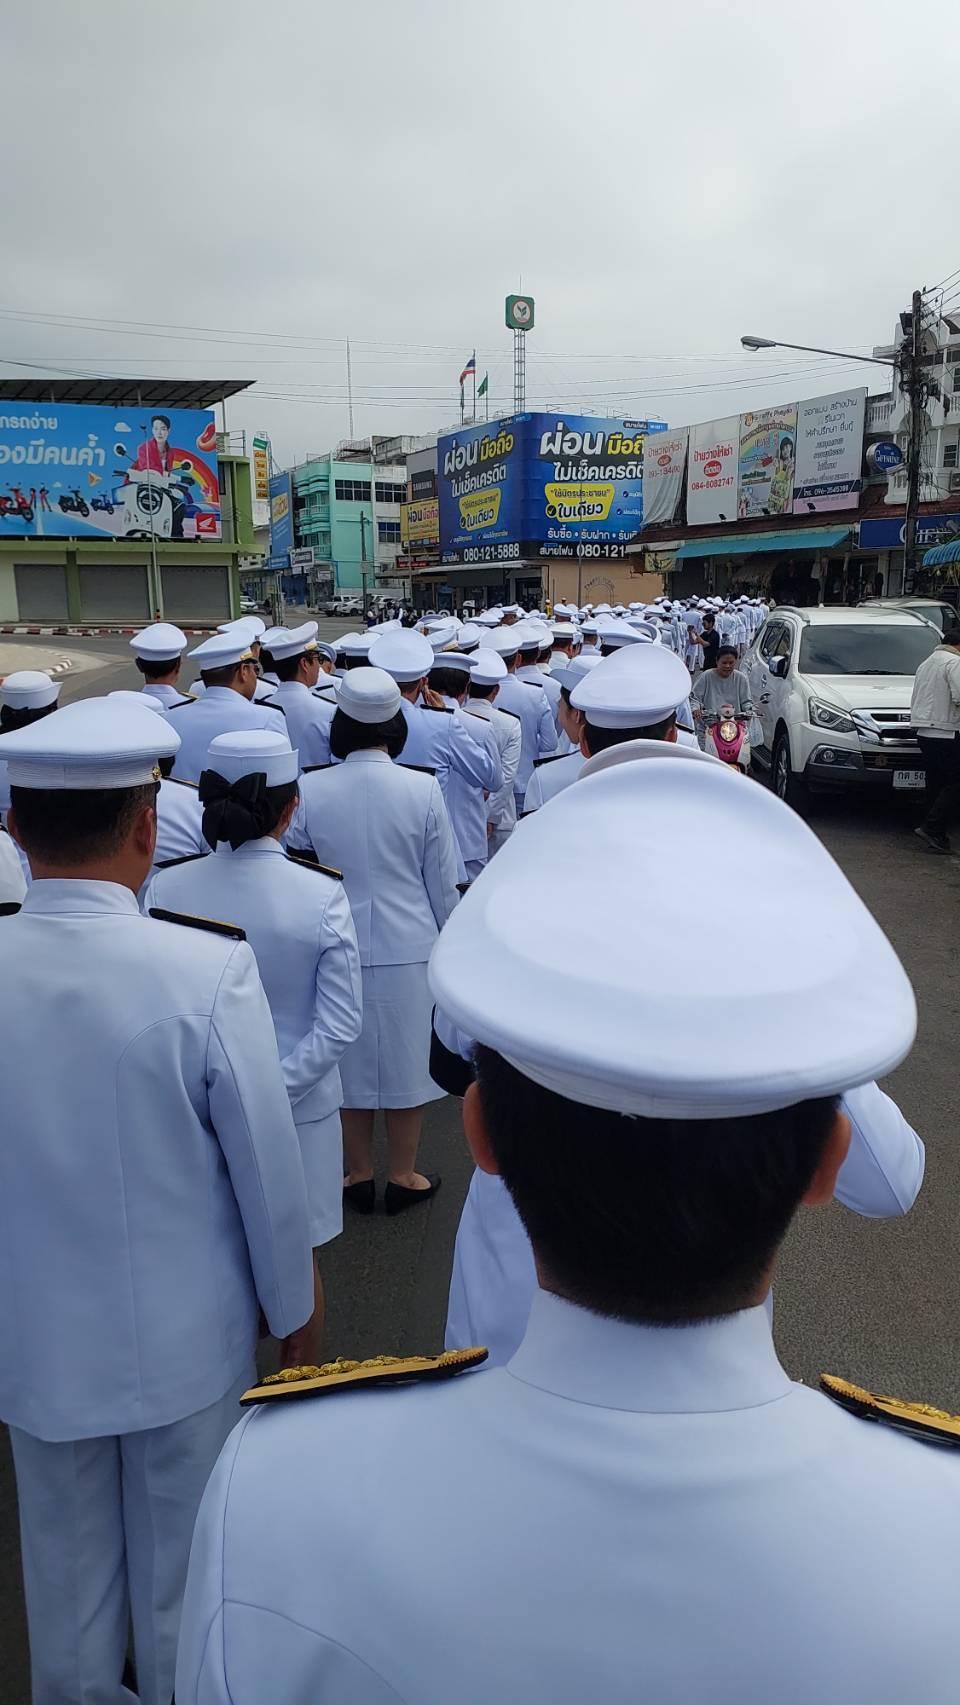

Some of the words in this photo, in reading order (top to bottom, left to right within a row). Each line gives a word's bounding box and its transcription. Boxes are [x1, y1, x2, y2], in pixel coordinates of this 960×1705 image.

[0, 411, 58, 430] กรถง่าย
[540, 422, 604, 455] ผ่อน
[0, 433, 105, 466] องมีคนค้ำ
[444, 439, 478, 475] ผ่อน
[480, 430, 514, 461] มือถือ
[451, 462, 507, 497] ไม่เช็คเครดิต
[467, 508, 495, 528] ใบเดียว
[558, 501, 604, 518] ใบเดียว
[463, 543, 520, 562] 080-121-5888
[576, 543, 626, 558] 080-121
